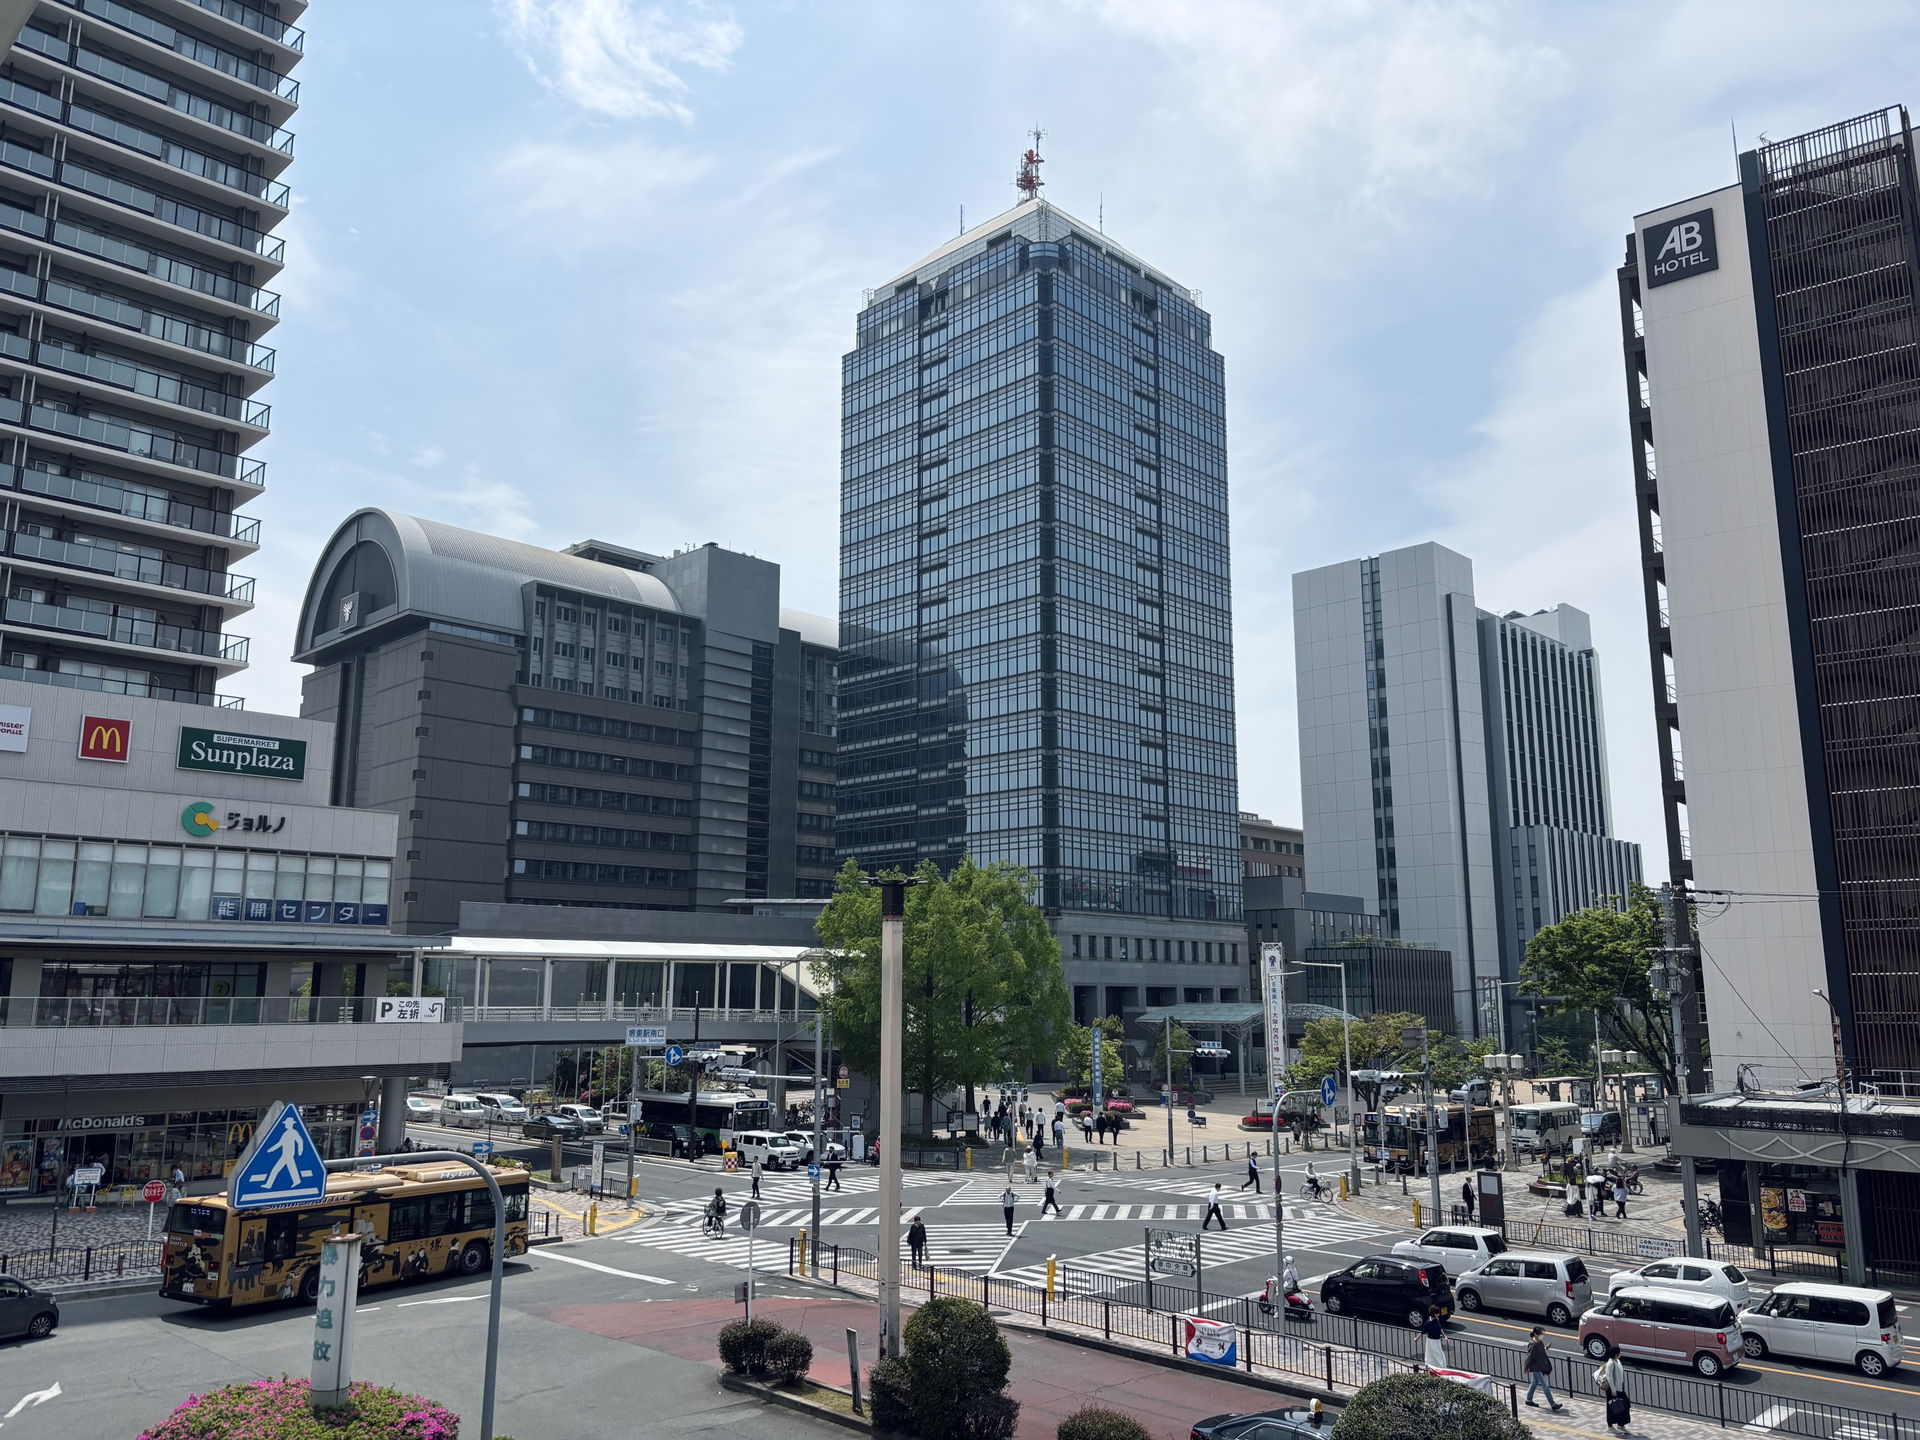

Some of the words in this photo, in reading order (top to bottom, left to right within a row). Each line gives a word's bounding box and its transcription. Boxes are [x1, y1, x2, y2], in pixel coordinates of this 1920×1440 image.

[1657, 221, 1703, 260] AB
[1654, 251, 1709, 276] HOTEL
[216, 735, 277, 748] SUPERMARKET
[190, 740, 295, 771] Sunplaza
[227, 812, 286, 834] ジョルノ
[217, 900, 382, 922] 能開センター
[381, 1002, 393, 1018] P
[397, 1008, 420, 1019] 左折
[399, 1000, 420, 1008] この先
[57, 1115, 145, 1130] McDonald's
